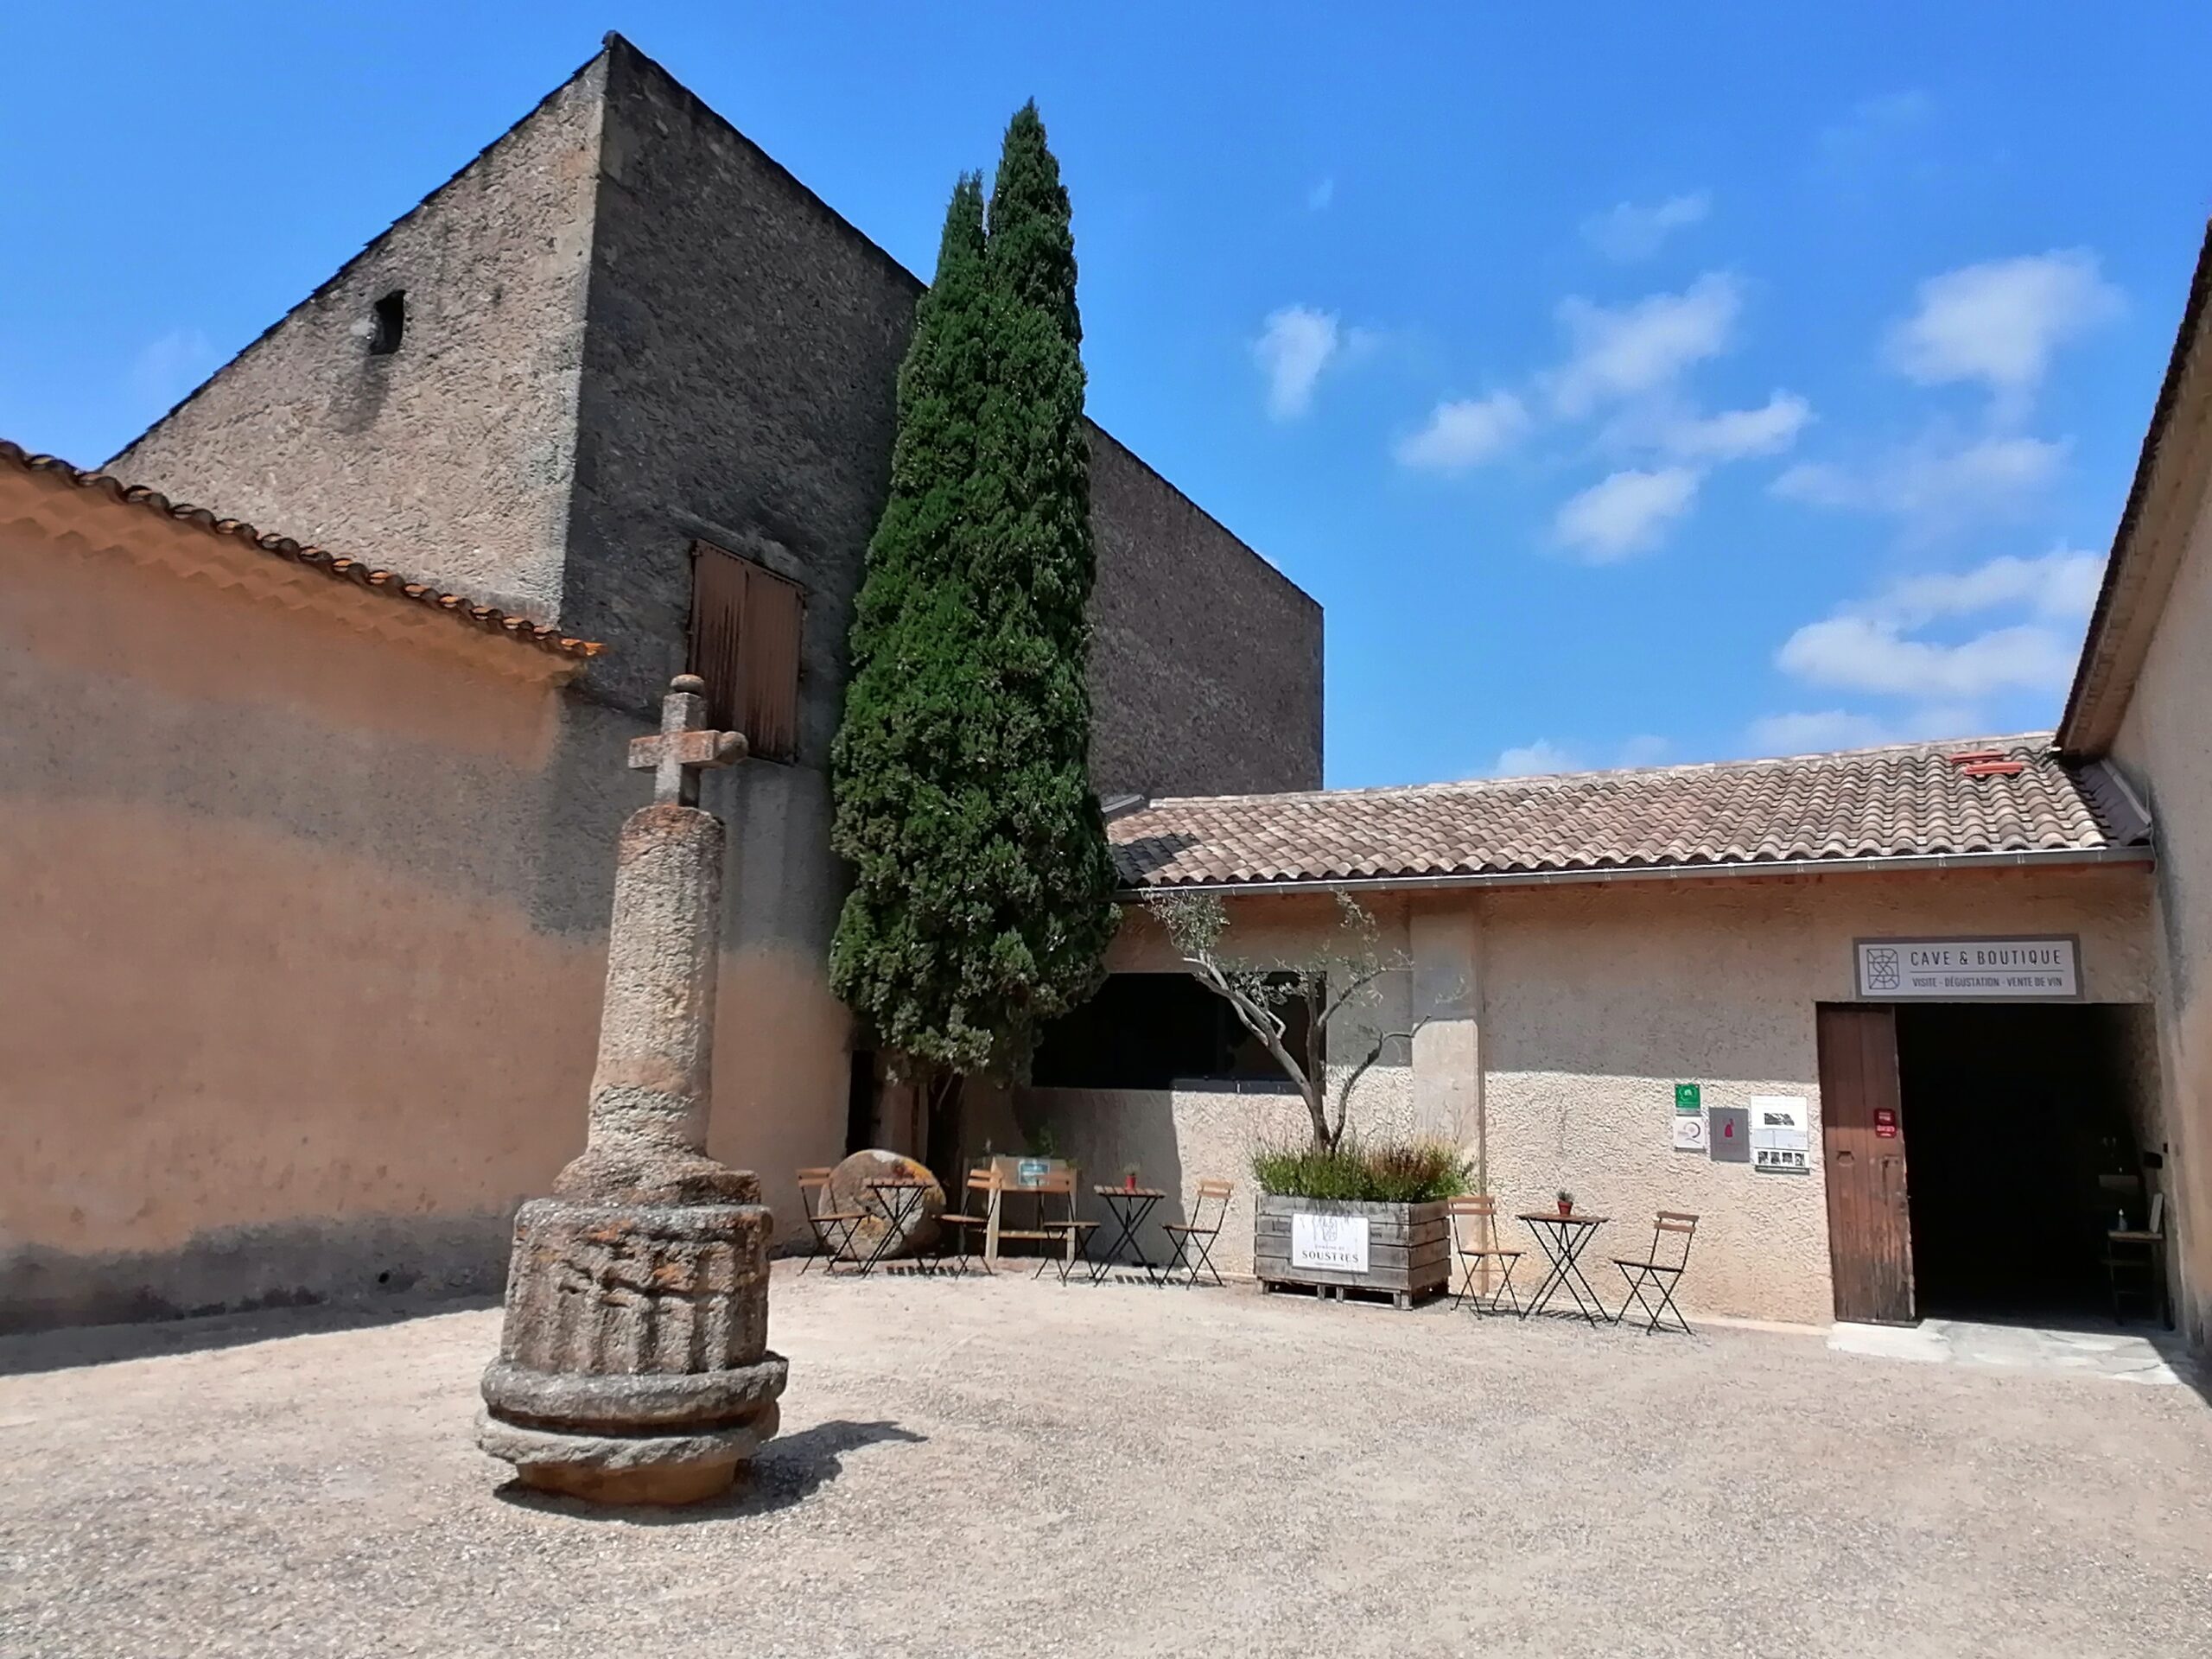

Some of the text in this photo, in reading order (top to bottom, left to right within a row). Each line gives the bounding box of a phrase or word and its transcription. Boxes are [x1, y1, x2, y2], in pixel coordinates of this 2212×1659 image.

[1910, 950, 2061, 966] CAVE & BOUTIQUE
[1912, 977, 1937, 987] VISITE
[1944, 976, 1999, 987] DÉGUSTATION
[2006, 976, 2032, 987] VENTE
[2034, 977, 2046, 987] DE
[2047, 976, 2063, 987] VIN
